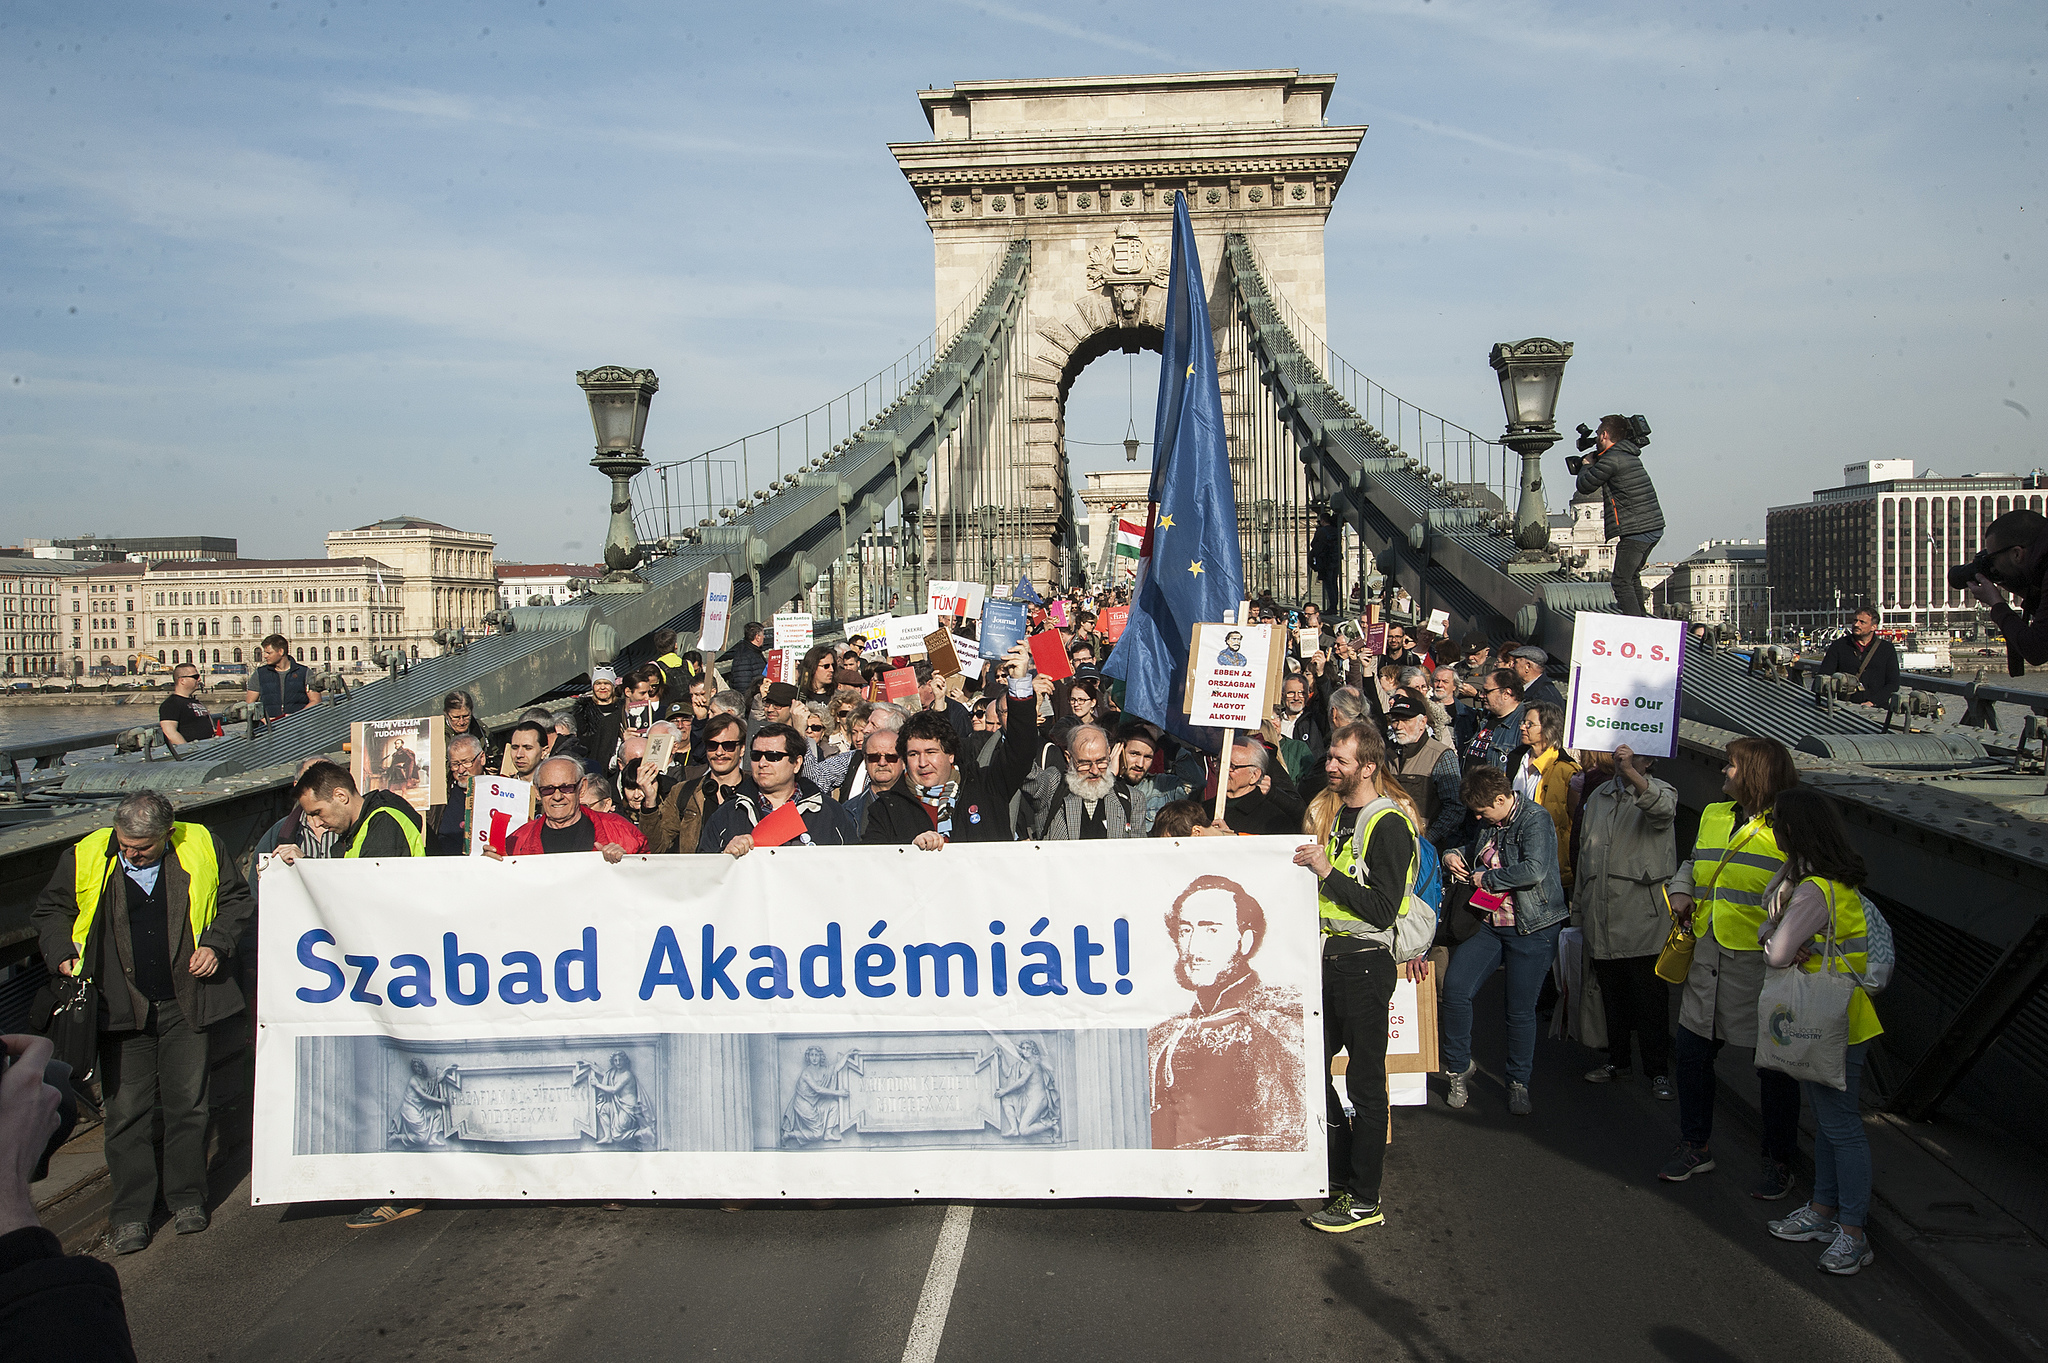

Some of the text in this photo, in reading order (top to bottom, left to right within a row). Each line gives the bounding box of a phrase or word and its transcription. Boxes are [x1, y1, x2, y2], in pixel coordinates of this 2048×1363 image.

[1846, 464, 1867, 473] SOFITEL
[709, 592, 728, 602] Borúra
[932, 594, 956, 612] TÜN
[992, 615, 1017, 626] Journal
[896, 641, 924, 649] INNOVÁCIÓ
[1591, 639, 1670, 661] S. O. S.
[885, 670, 907, 679] KORALL
[1213, 669, 1240, 677] EBBEN
[1207, 679, 1256, 689] ORSZÁGBAN
[1210, 691, 1250, 699] AKARUNK
[1212, 702, 1246, 710] NAGYOT
[1590, 693, 1664, 710] Save Our
[1209, 713, 1246, 721] ALKOTNI!
[374, 719, 421, 729] NEM VESZEM
[1585, 715, 1664, 734] Sciences!
[374, 728, 420, 738] TUDOMÁSUL
[490, 783, 515, 799] Save
[295, 916, 1133, 1009] Szabad Akadémiát!
[1789, 1031, 1823, 1039] CHEMISTRY
[1771, 1053, 1810, 1067] www.rsc.org
[920, 1074, 979, 1091] KEZDETT
